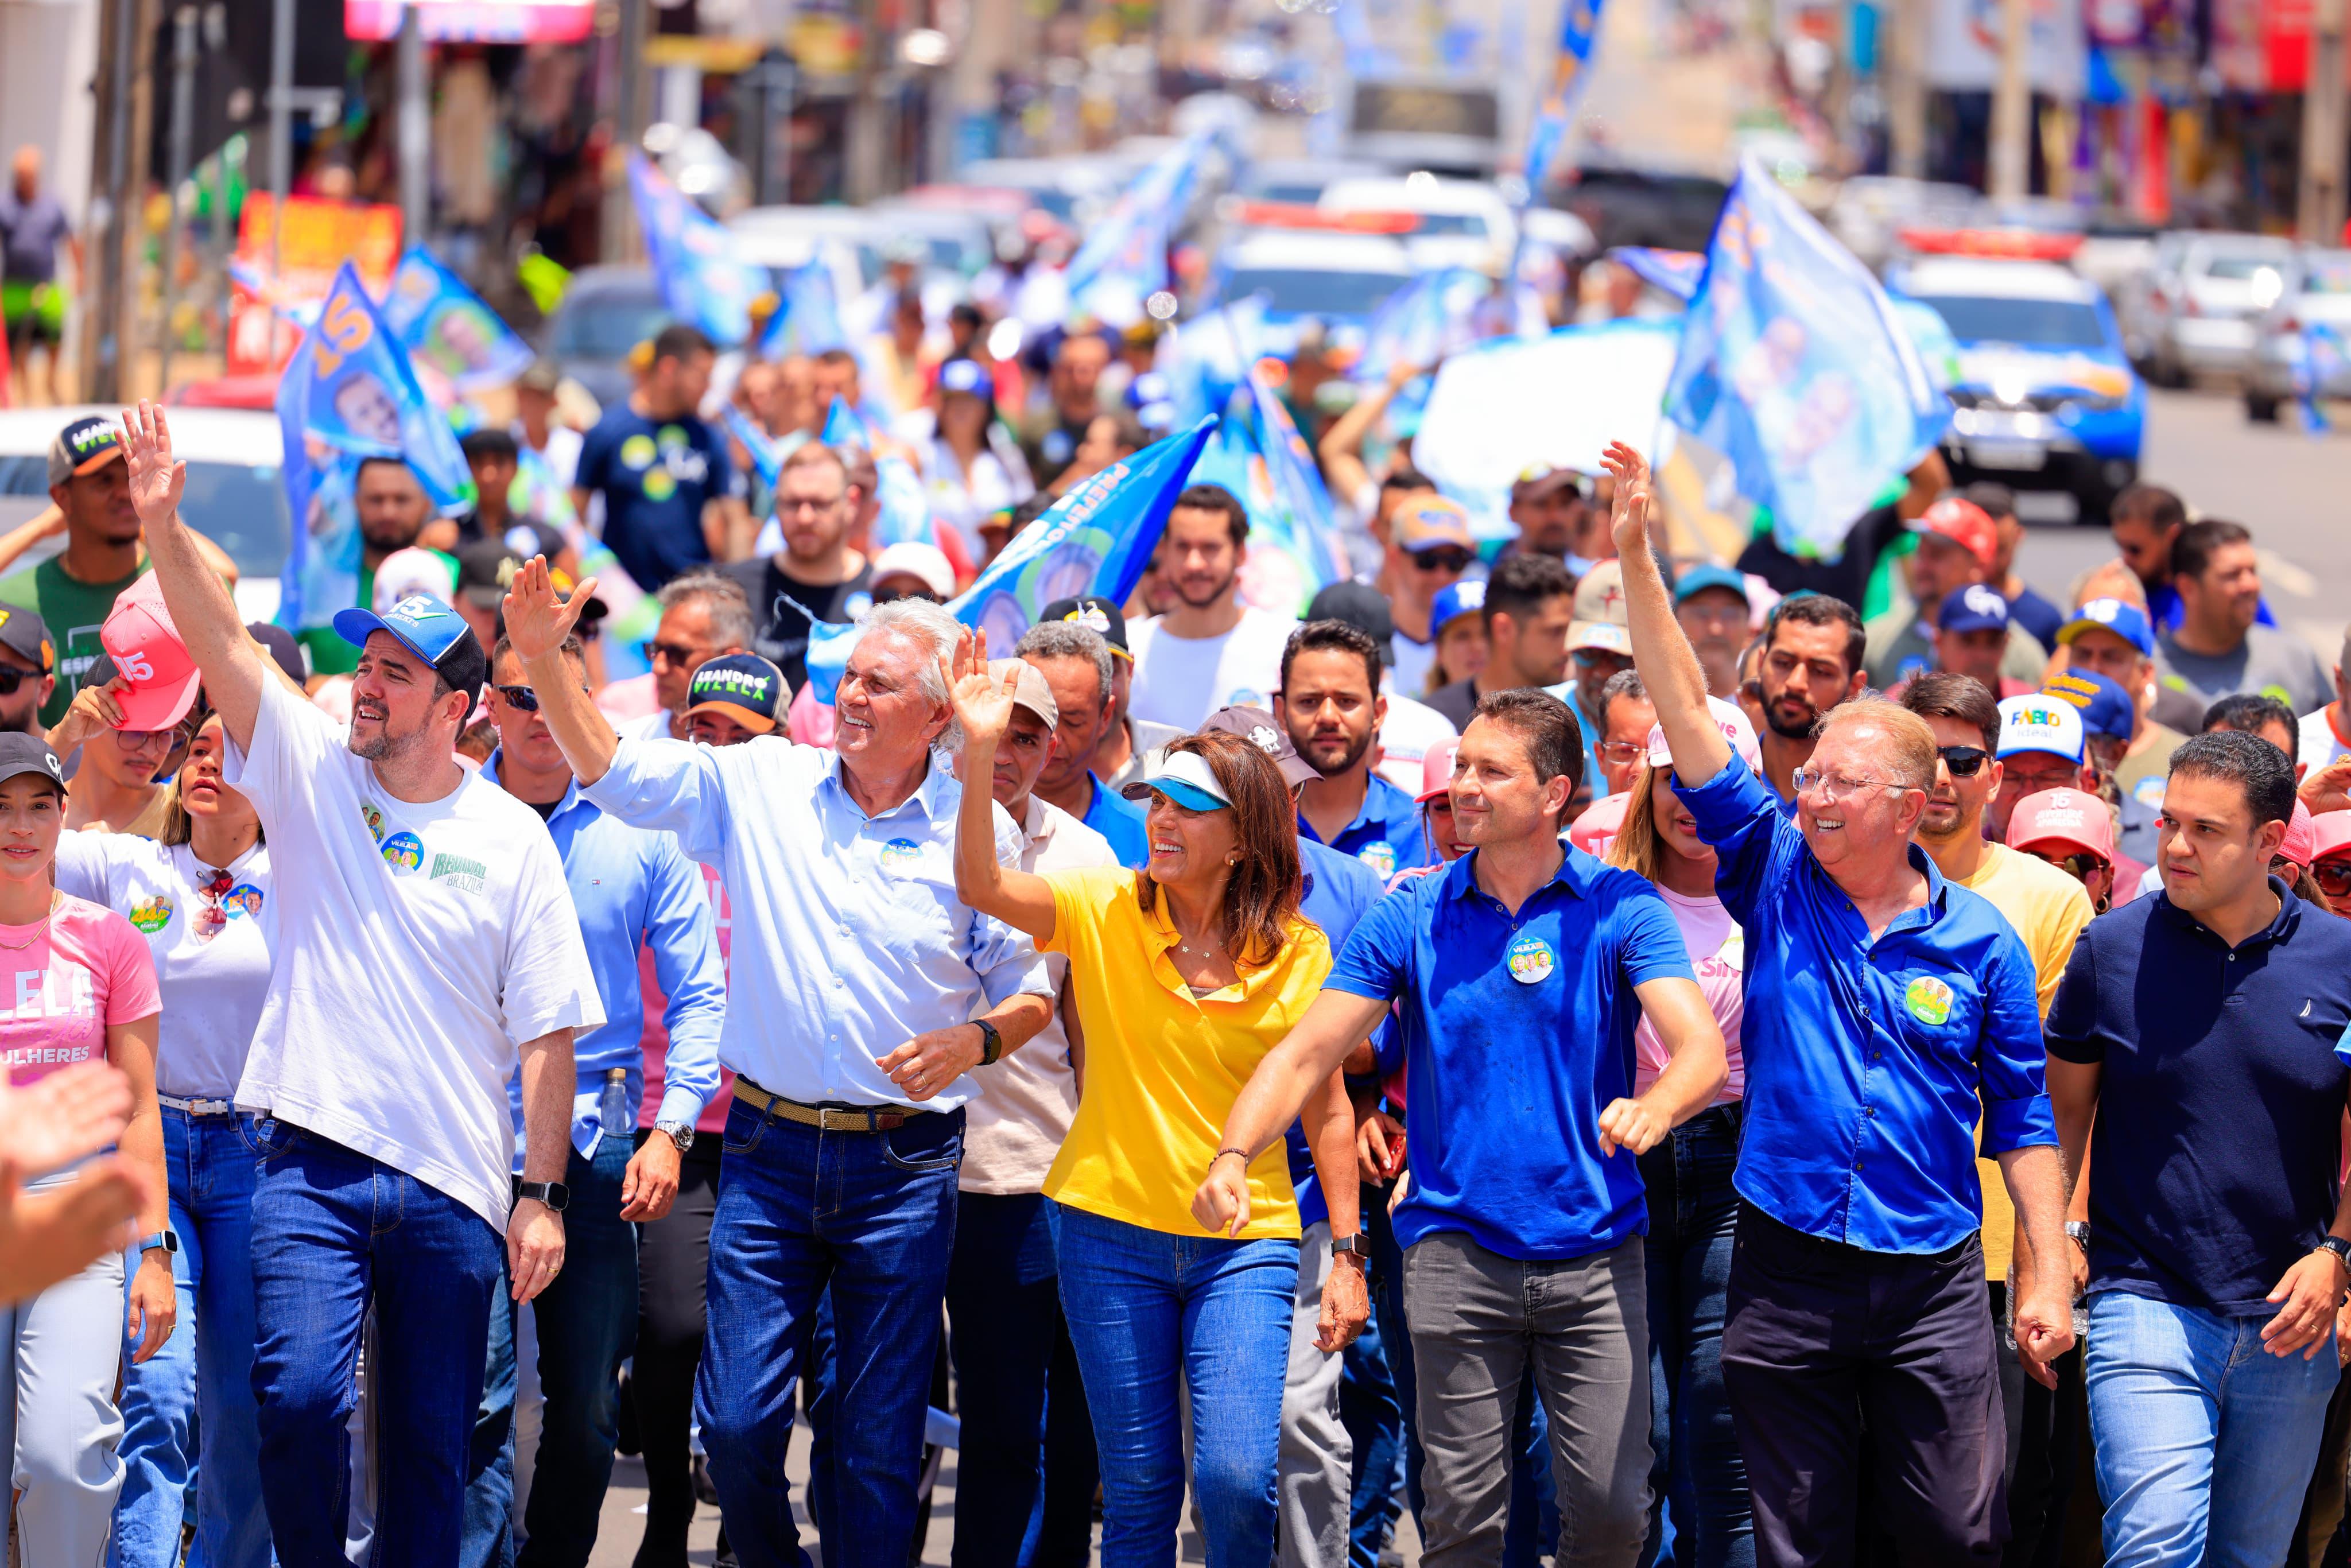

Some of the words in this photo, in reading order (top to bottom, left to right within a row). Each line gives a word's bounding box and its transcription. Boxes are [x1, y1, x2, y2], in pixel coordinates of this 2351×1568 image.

[112, 652, 154, 681] 15
[693, 681, 765, 701] VILELA
[2018, 728, 2053, 739] ideal
[2049, 793, 2071, 809] 15
[447, 874, 482, 897] BRAZIL
[227, 894, 244, 909] 15
[0, 967, 96, 1020] ELA
